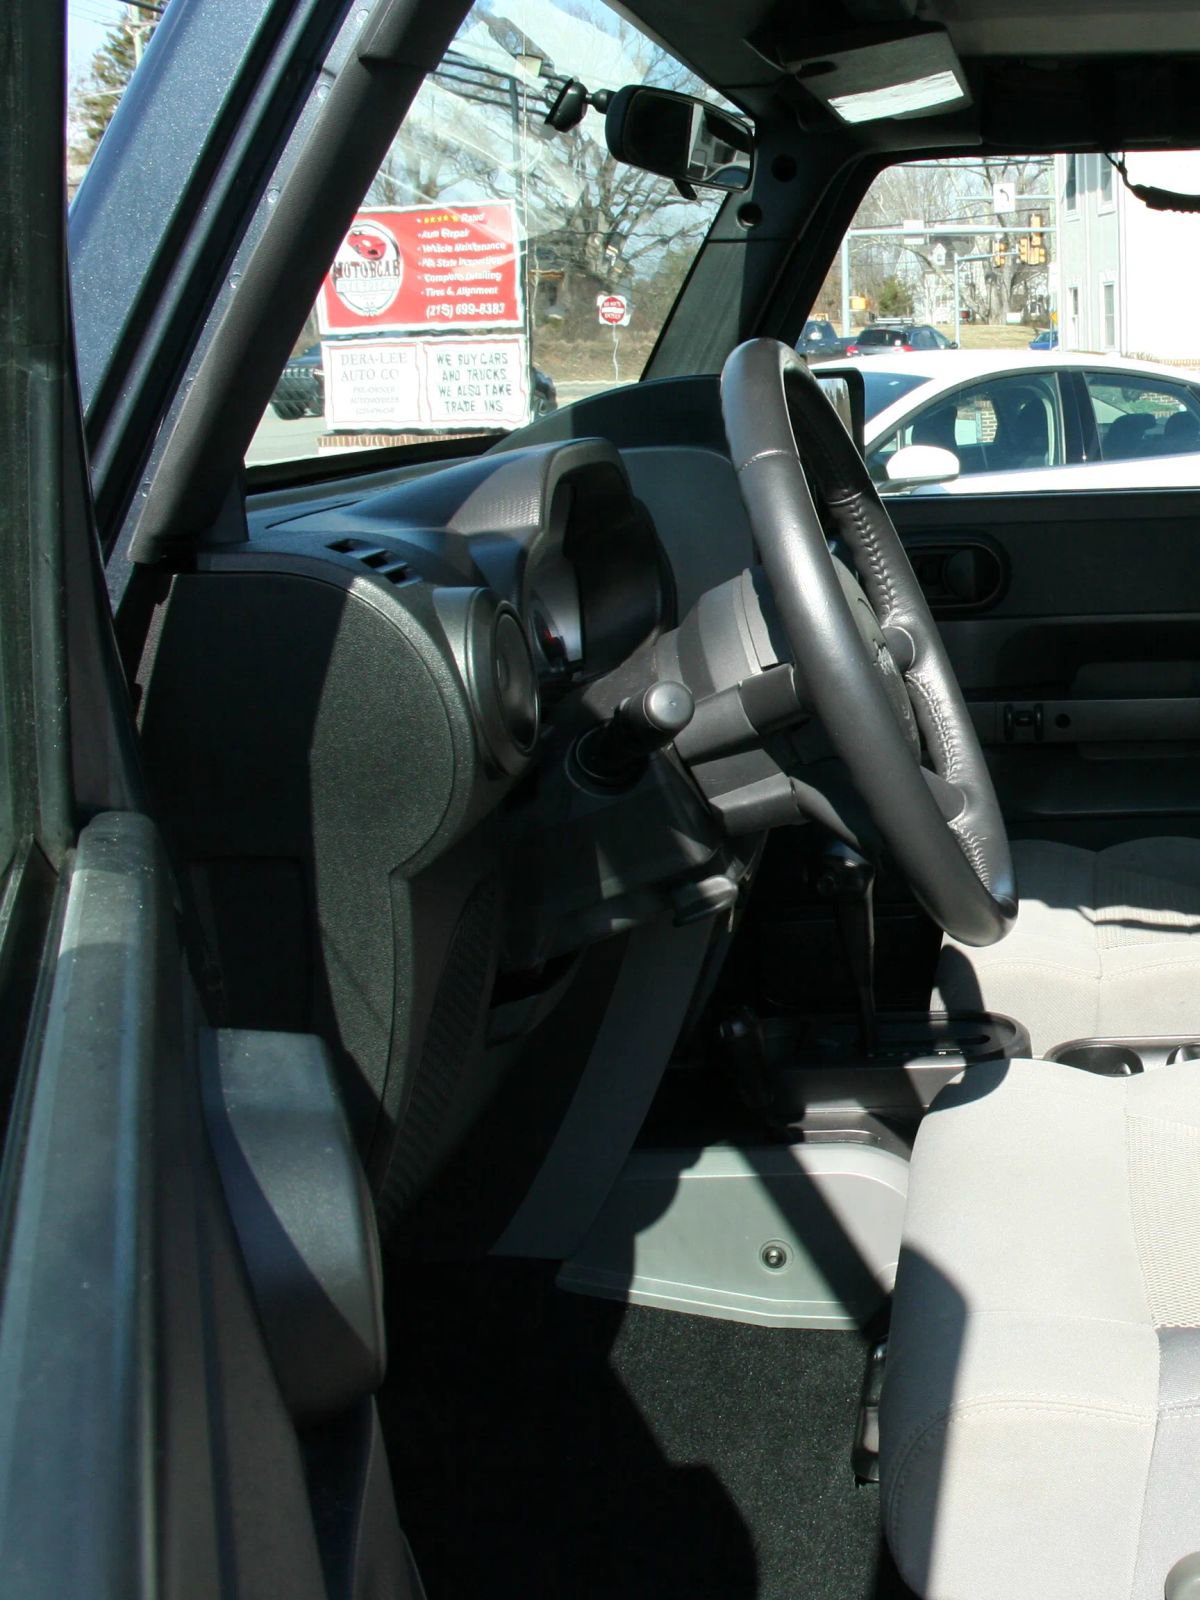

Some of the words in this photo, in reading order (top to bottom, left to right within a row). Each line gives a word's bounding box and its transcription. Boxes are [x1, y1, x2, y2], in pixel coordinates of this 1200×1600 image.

[425, 287, 445, 297] Tires
[456, 287, 498, 297] Alignment
[426, 303, 454, 319] (215)
[341, 352, 407, 366] DERA-LEE
[437, 353, 451, 366] WE
[458, 354, 476, 366] BUY
[480, 352, 508, 364] CARS
[341, 368, 375, 382] AUTO
[442, 369, 460, 381] AND
[467, 368, 506, 381] TRUCKS
[485, 383, 512, 396] TAKE
[445, 400, 475, 413] TRADE
